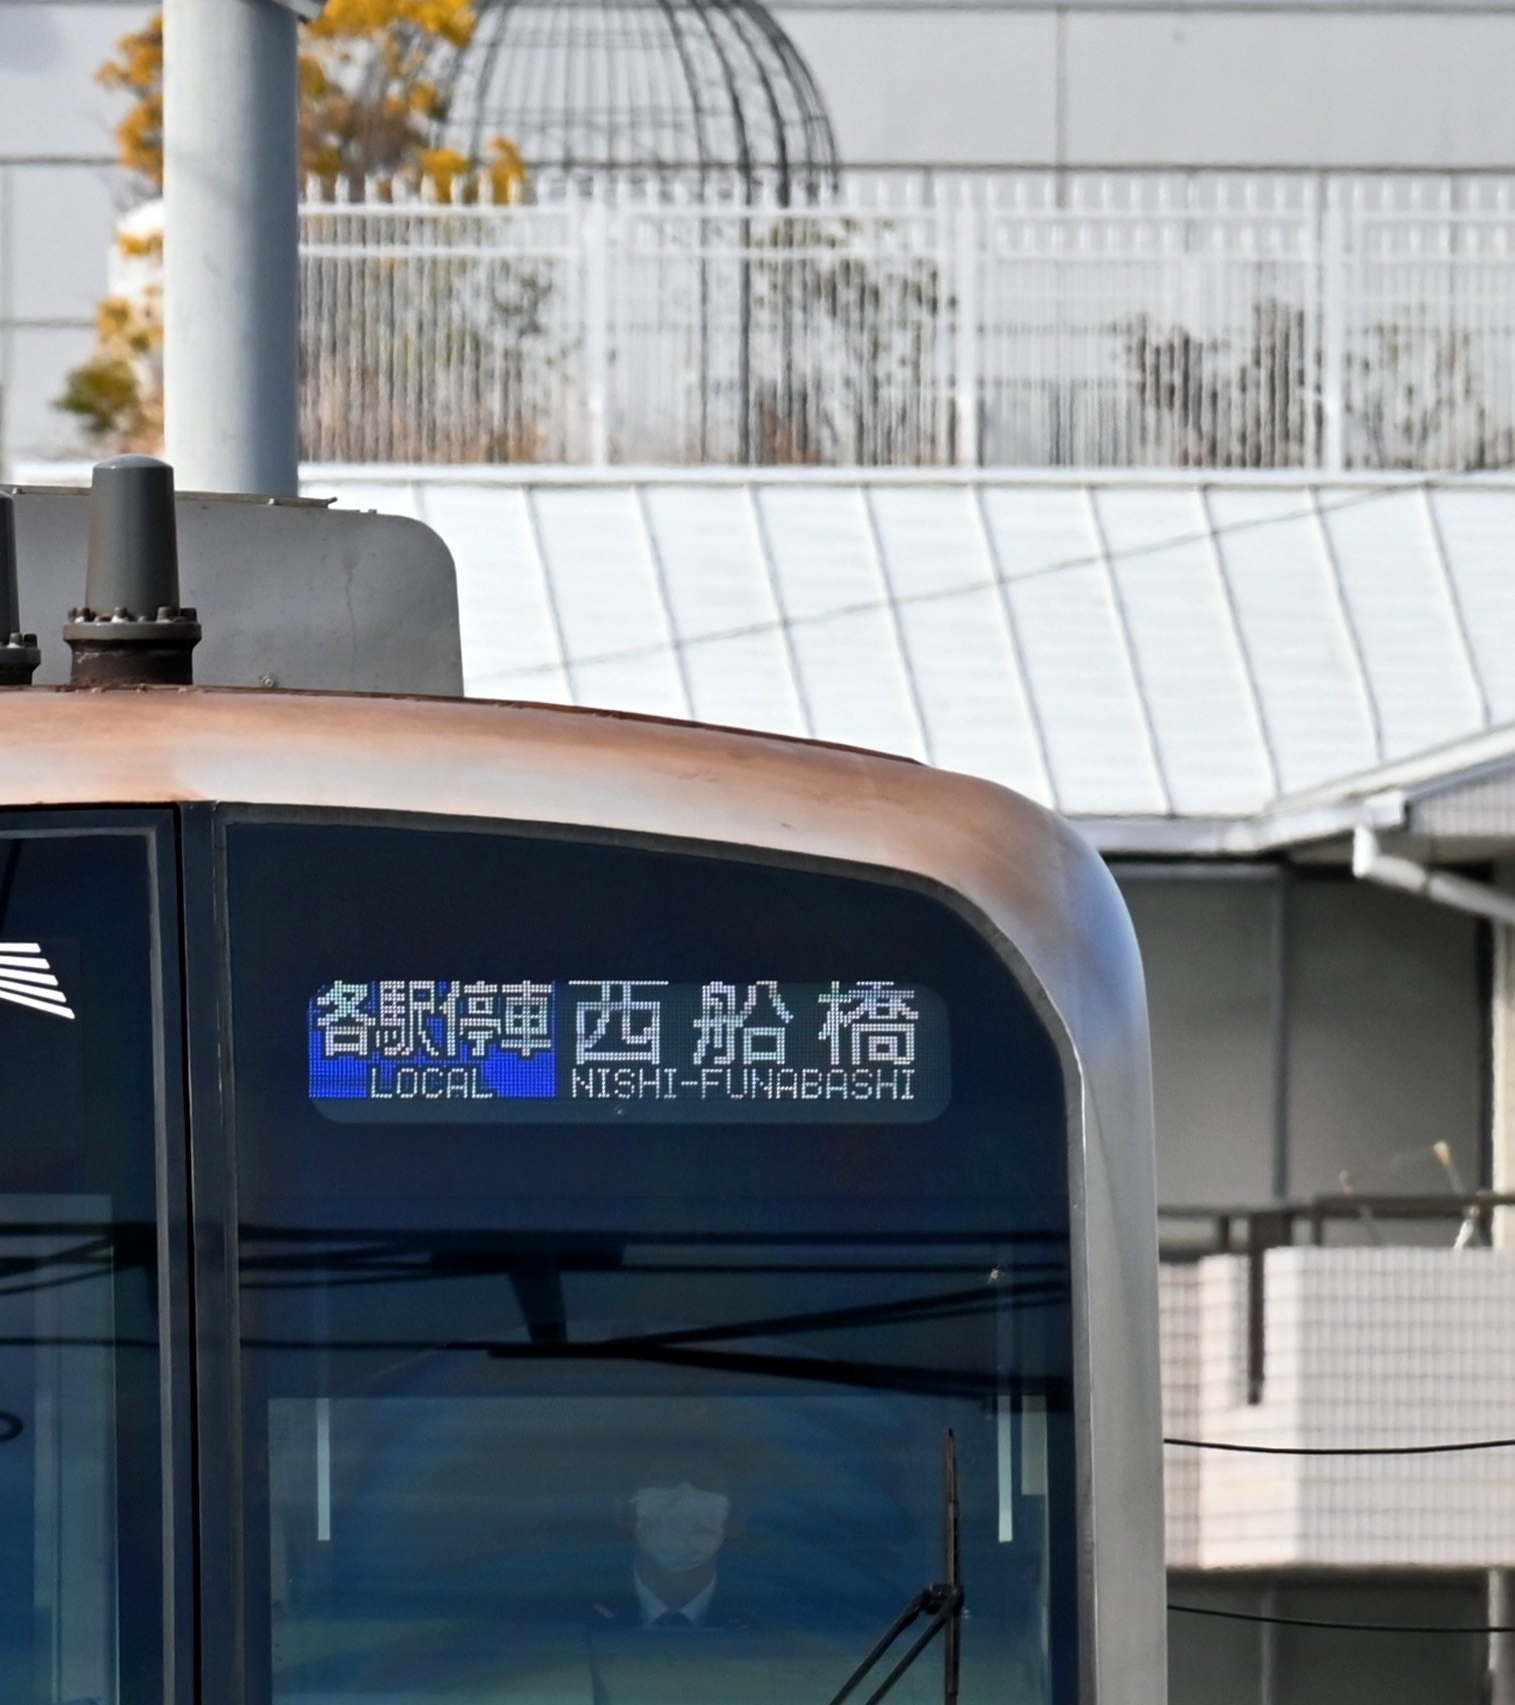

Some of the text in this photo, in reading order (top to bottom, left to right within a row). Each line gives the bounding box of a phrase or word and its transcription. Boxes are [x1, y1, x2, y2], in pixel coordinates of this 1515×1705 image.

[317, 980, 552, 1057] 各駅停車
[568, 980, 919, 1065] 西船橋
[371, 1067, 493, 1099] LOCAL
[571, 1067, 915, 1100] NISHI-FUNABASHI
